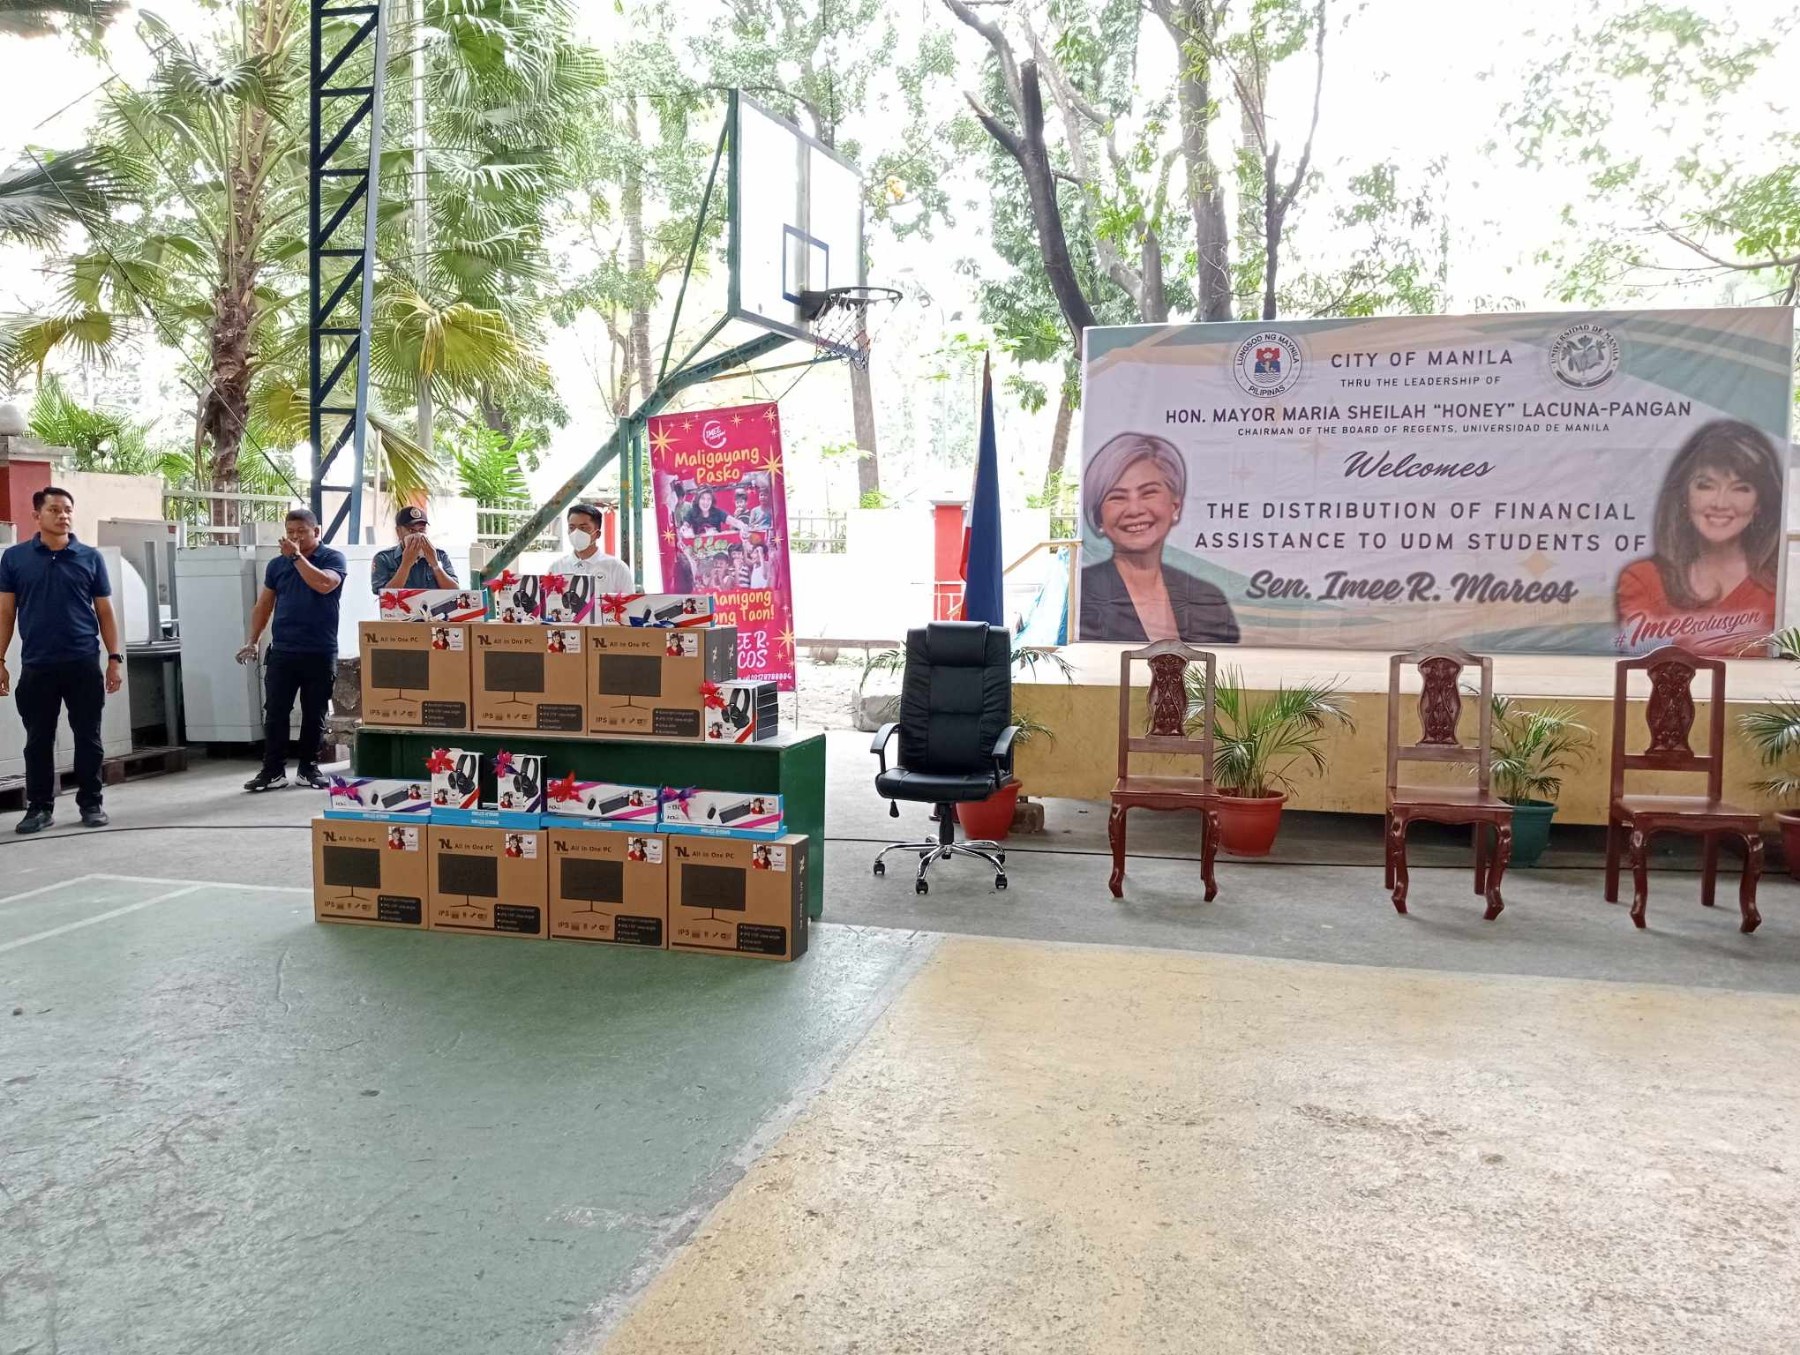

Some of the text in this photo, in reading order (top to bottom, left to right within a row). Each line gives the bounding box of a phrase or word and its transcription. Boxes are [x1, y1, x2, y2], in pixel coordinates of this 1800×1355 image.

[1236, 333, 1300, 366] LUNGSOD NG MAYNILA
[1551, 324, 1590, 364] UNIVERSIDAD
[1604, 332, 1619, 361] MANILA
[1330, 349, 1513, 368] CITY OF MANILA
[1247, 384, 1286, 396] PILIPINAS
[1340, 375, 1501, 388] THRU THE LEADERSHIP OF
[1165, 409, 1206, 424] HON.
[1212, 407, 1275, 423] MAYOR
[1282, 406, 1340, 421] MARIA
[1347, 404, 1426, 420] SHEILAH
[1522, 401, 1692, 418] LACUNA-PANGAN
[1238, 423, 1610, 436] CHAIRMAN OF THE BOARD OF REGENTS, UNIVERSIDAD DE MANILA
[674, 447, 760, 469] Maligayang
[1343, 450, 1495, 478] Welcomes
[696, 466, 741, 484] Pasko
[1206, 502, 1636, 520] THE DISTRIBUTION OF FINANCIAL
[1195, 532, 1647, 551] ASSISTANCE TO UDM STUDENTS OF
[1246, 569, 1579, 604] Sen. Imee R. Marcos
[740, 604, 775, 622] Taon!
[753, 630, 770, 649] R.
[737, 649, 768, 669] COS
